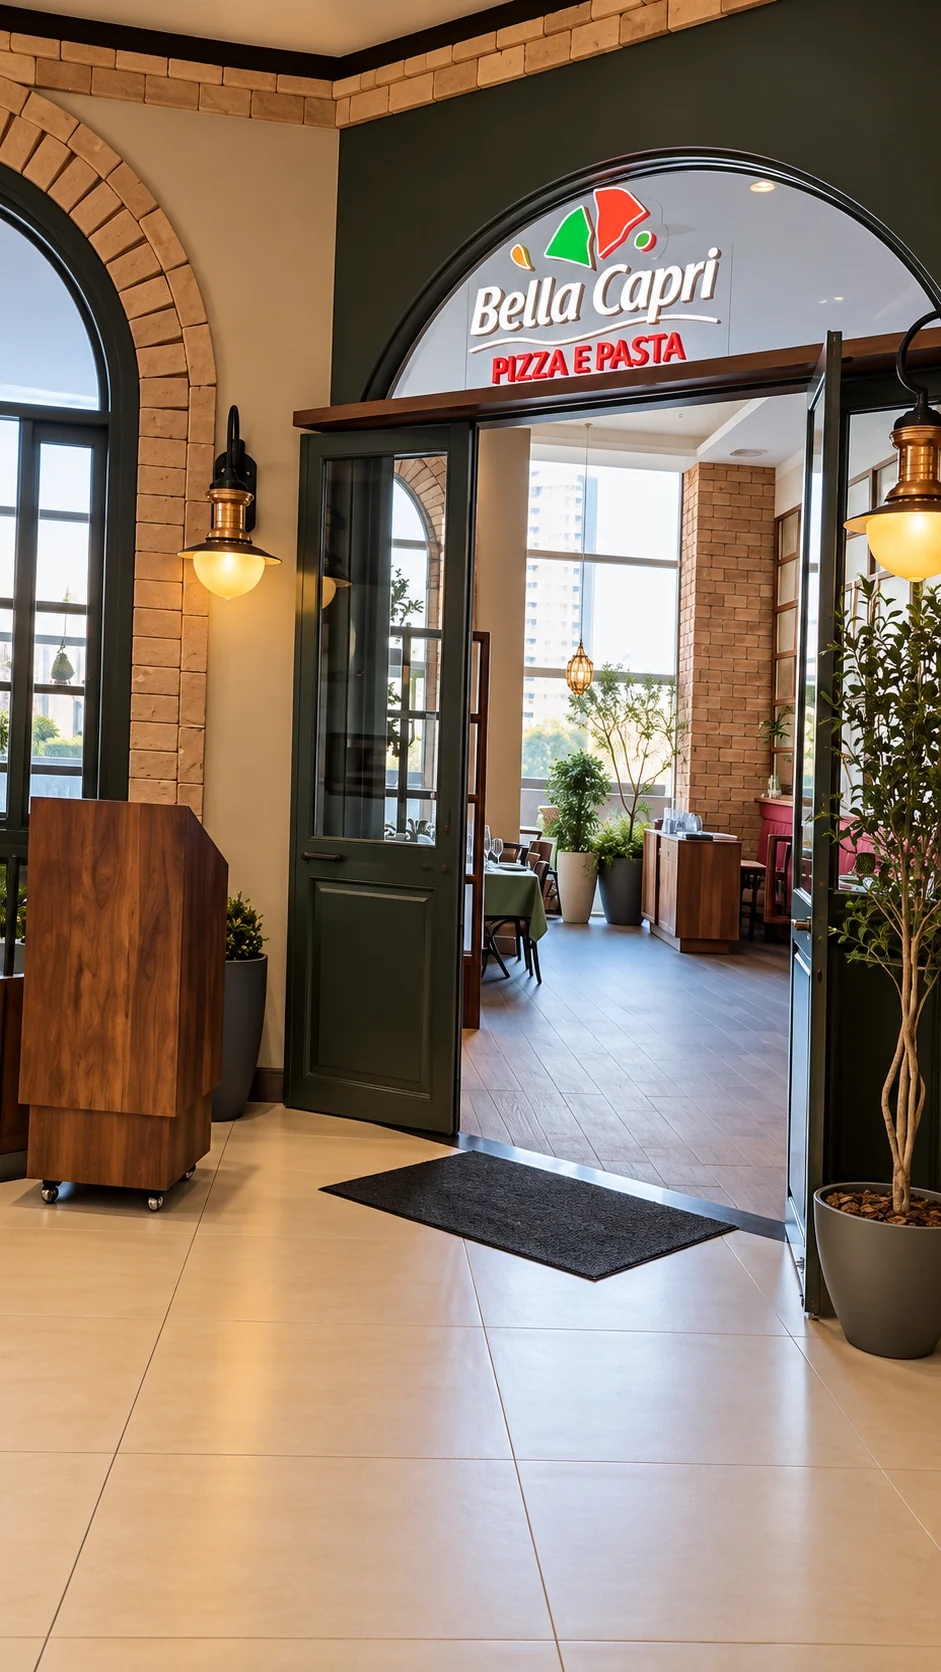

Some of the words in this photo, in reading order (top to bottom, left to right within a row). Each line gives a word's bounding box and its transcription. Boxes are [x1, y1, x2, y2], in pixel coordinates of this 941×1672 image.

[470, 277, 585, 336] Bella
[592, 247, 722, 324] Capri
[491, 348, 569, 384] PIZZA
[573, 345, 592, 374] E
[595, 332, 687, 371] PASTA
